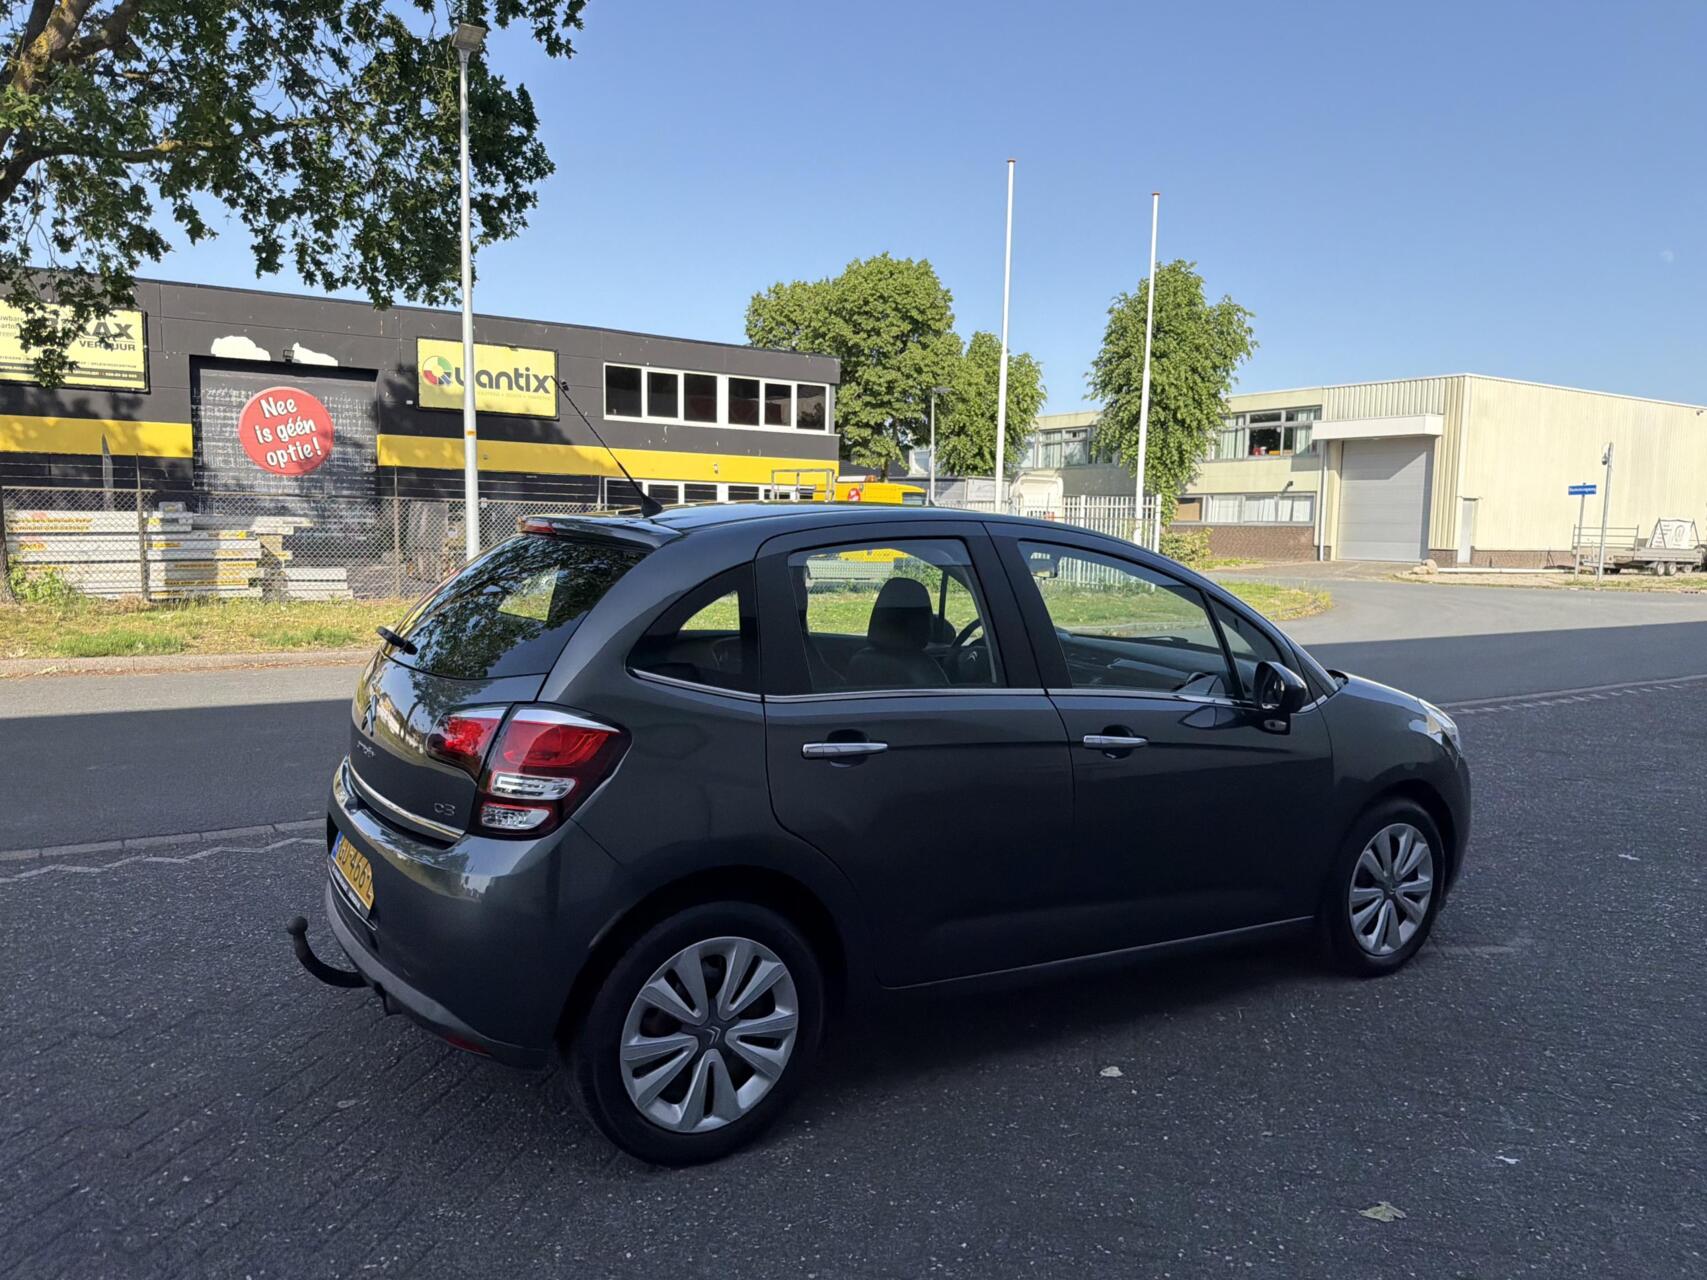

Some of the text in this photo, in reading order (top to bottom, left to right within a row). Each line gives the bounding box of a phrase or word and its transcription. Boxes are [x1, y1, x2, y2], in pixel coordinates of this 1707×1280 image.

[79, 340, 136, 352] VERUUR
[259, 396, 298, 418] Nee
[254, 416, 316, 444] is géén
[266, 436, 322, 468] optie!
